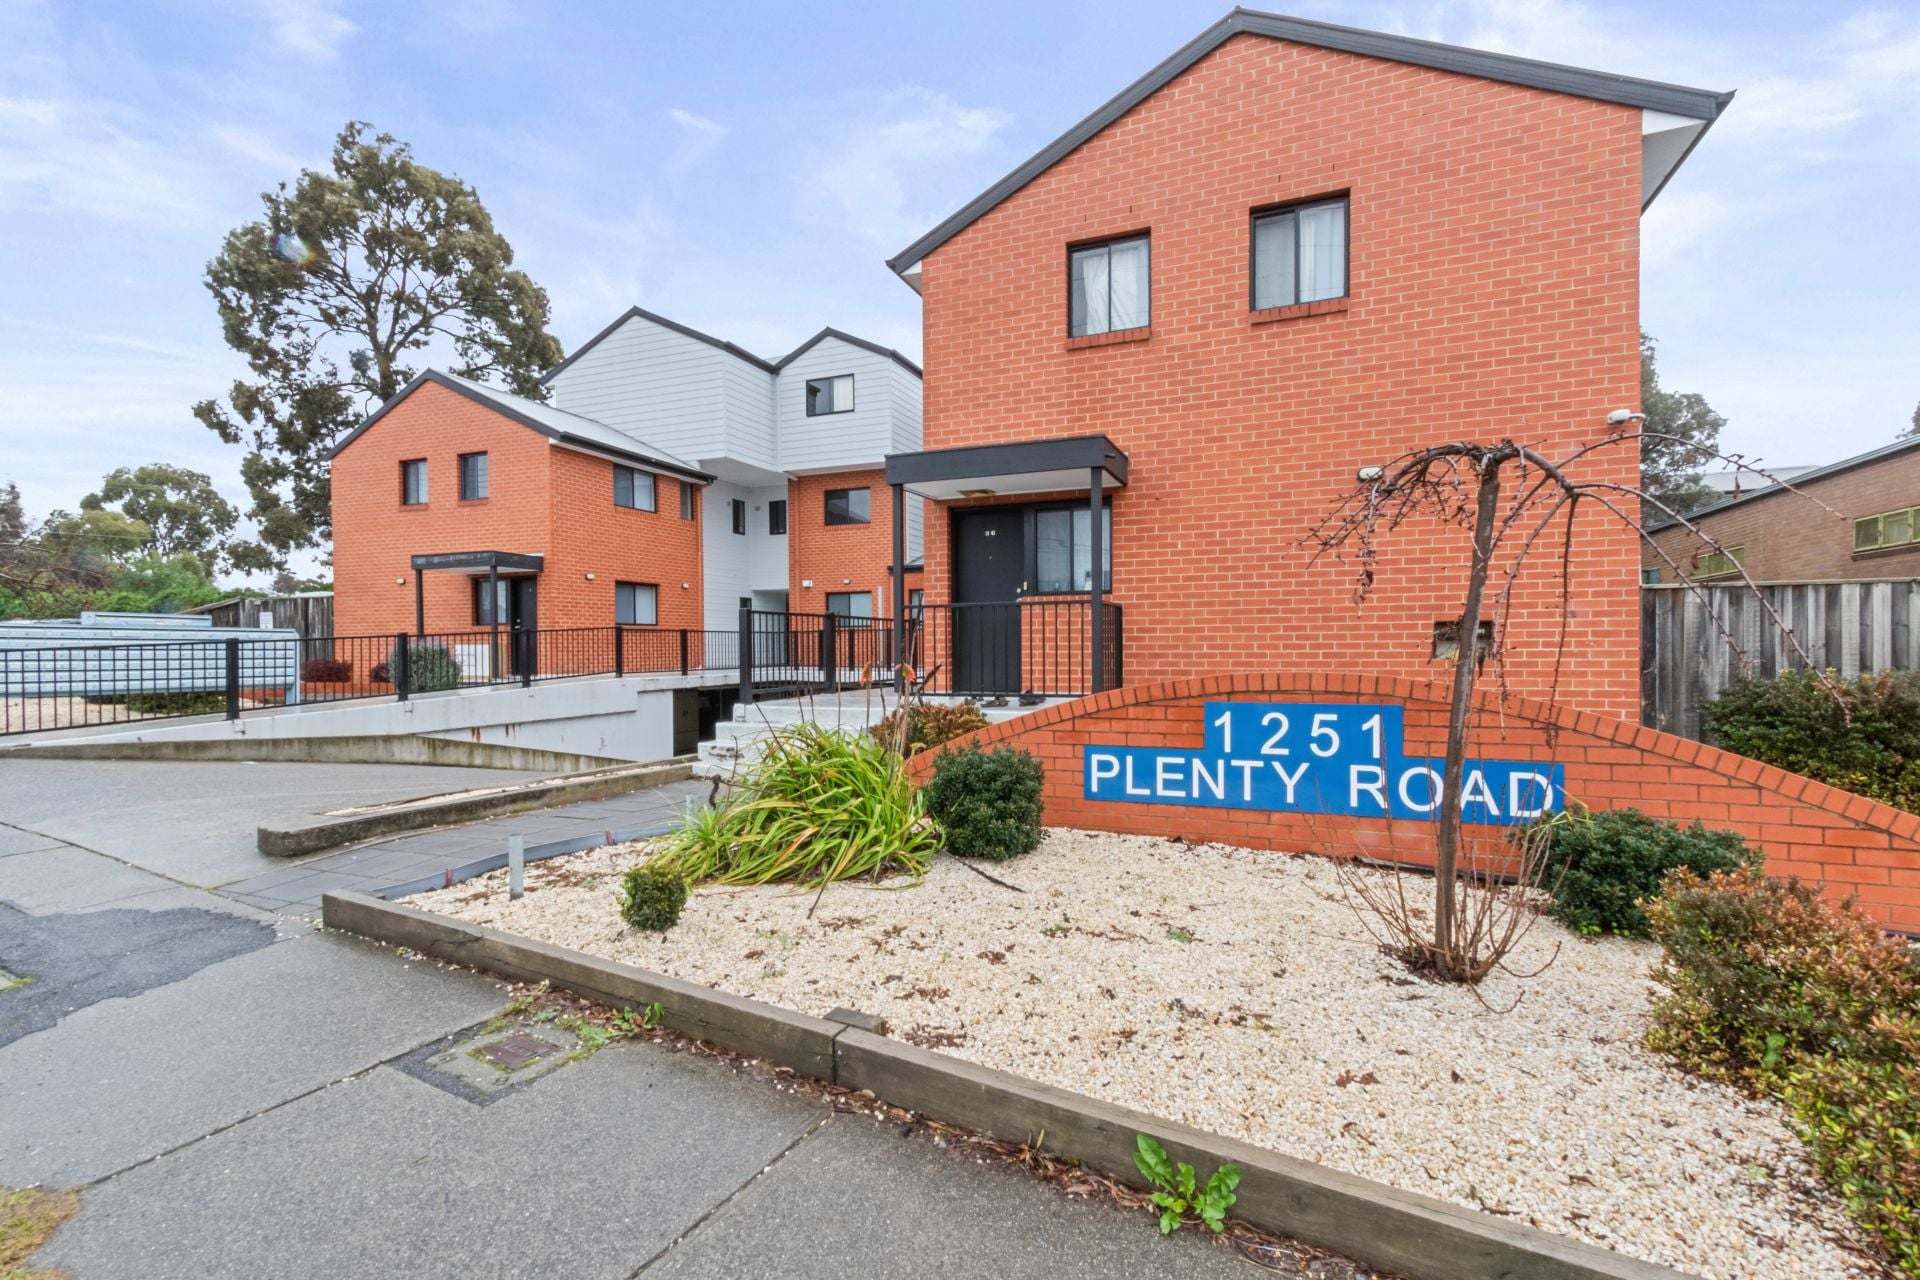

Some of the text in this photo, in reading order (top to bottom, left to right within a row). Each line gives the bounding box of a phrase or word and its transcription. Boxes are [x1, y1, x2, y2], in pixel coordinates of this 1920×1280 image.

[1214, 711, 1382, 758] 1251
[1091, 754, 1554, 817] PLENTY ROAD
